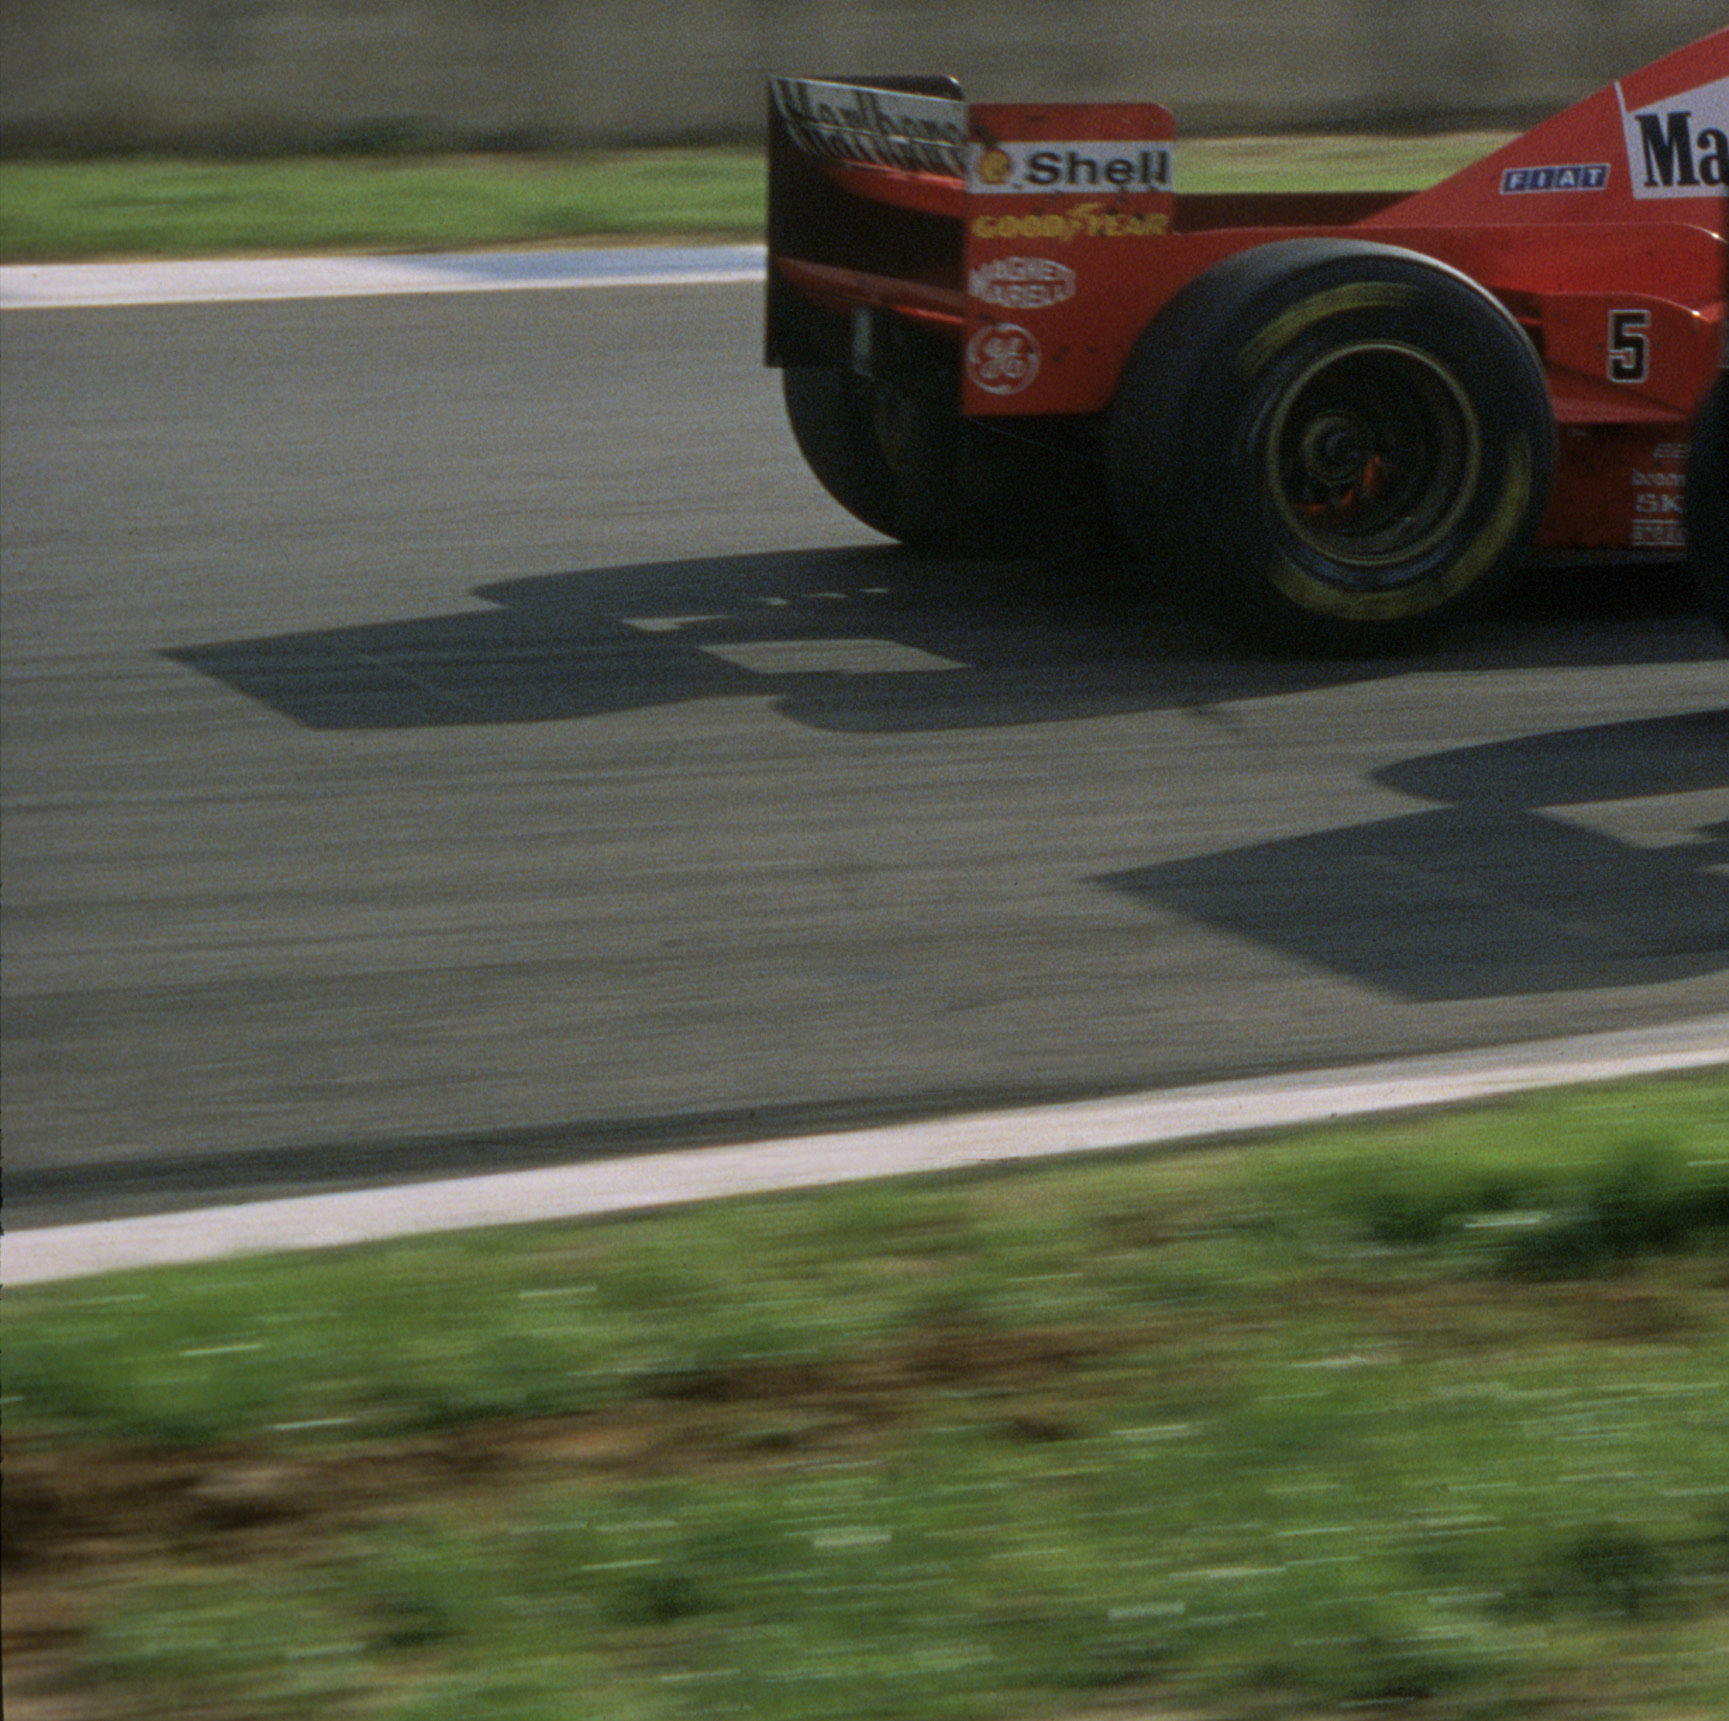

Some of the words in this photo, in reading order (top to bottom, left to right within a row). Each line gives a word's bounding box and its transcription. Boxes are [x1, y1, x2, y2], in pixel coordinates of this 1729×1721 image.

[1027, 151, 1170, 184] Shell
[1505, 166, 1605, 191] FIAT
[1608, 311, 1649, 382] 5
